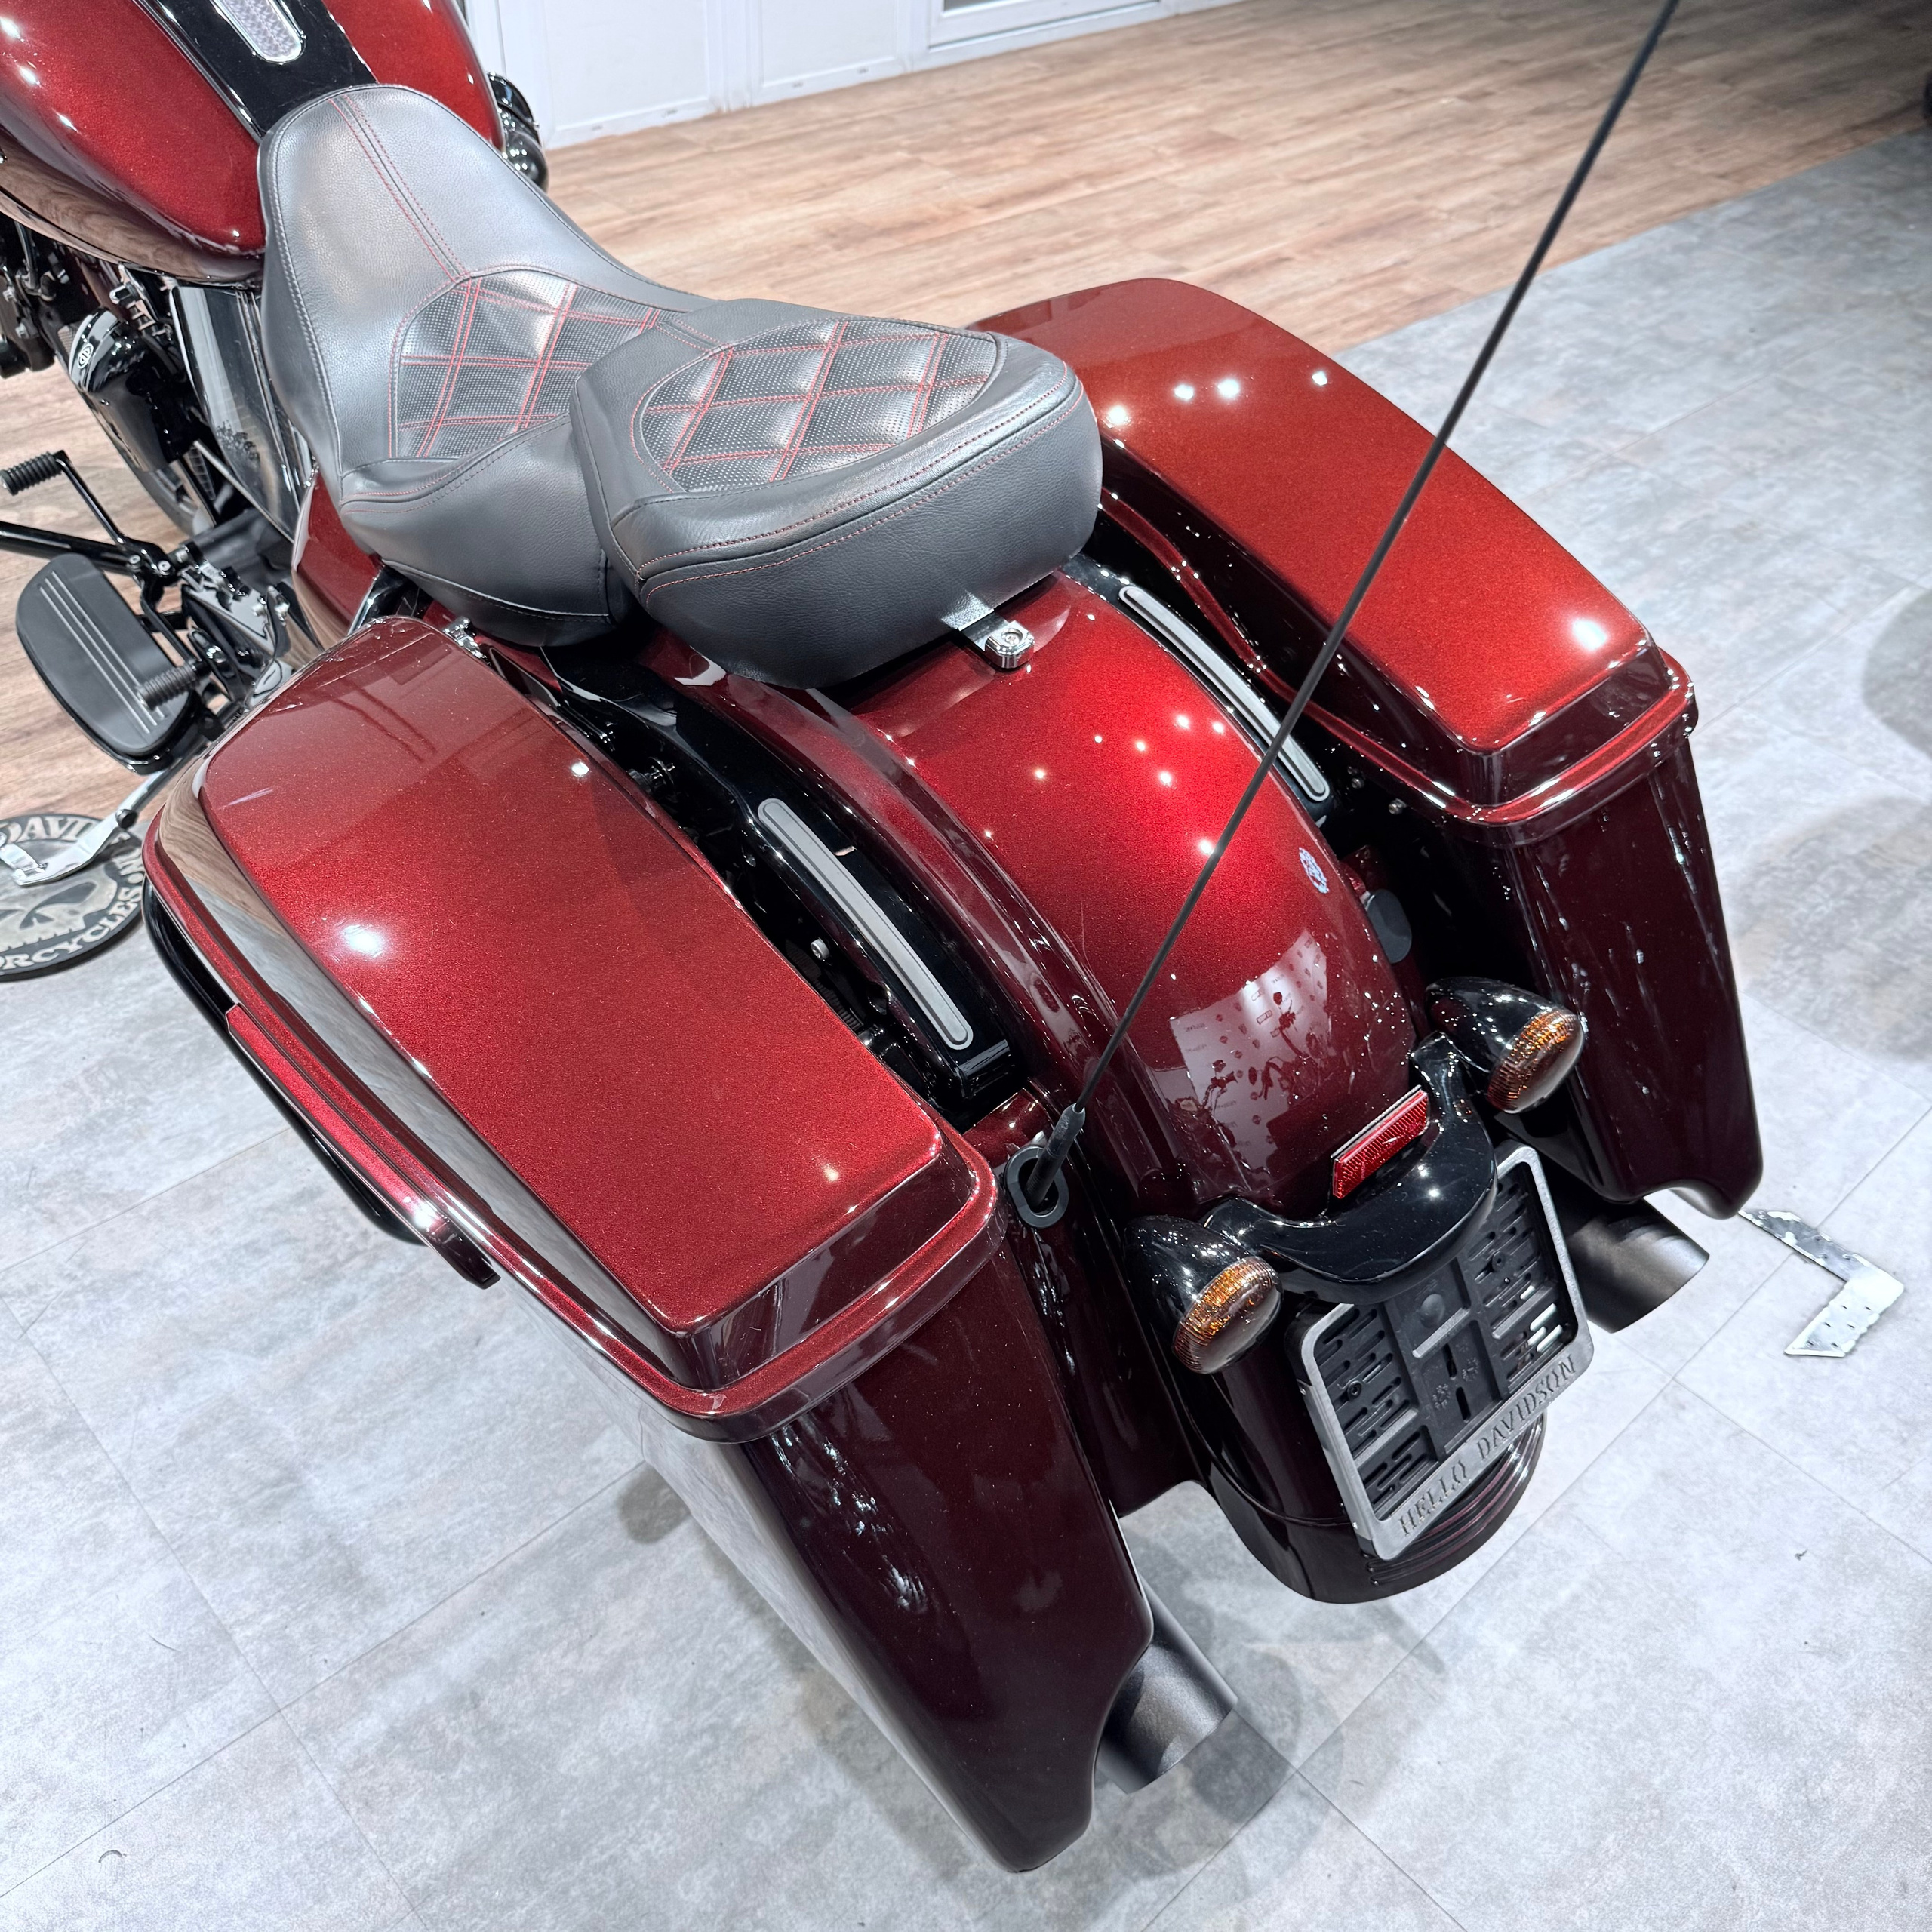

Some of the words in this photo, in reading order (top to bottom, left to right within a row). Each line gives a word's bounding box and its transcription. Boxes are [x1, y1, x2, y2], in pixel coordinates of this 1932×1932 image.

[0, 886, 143, 970] RCYCLES
[1398, 1460, 1468, 1537] HELLO
[1475, 1353, 1577, 1461] DAVIDSON
